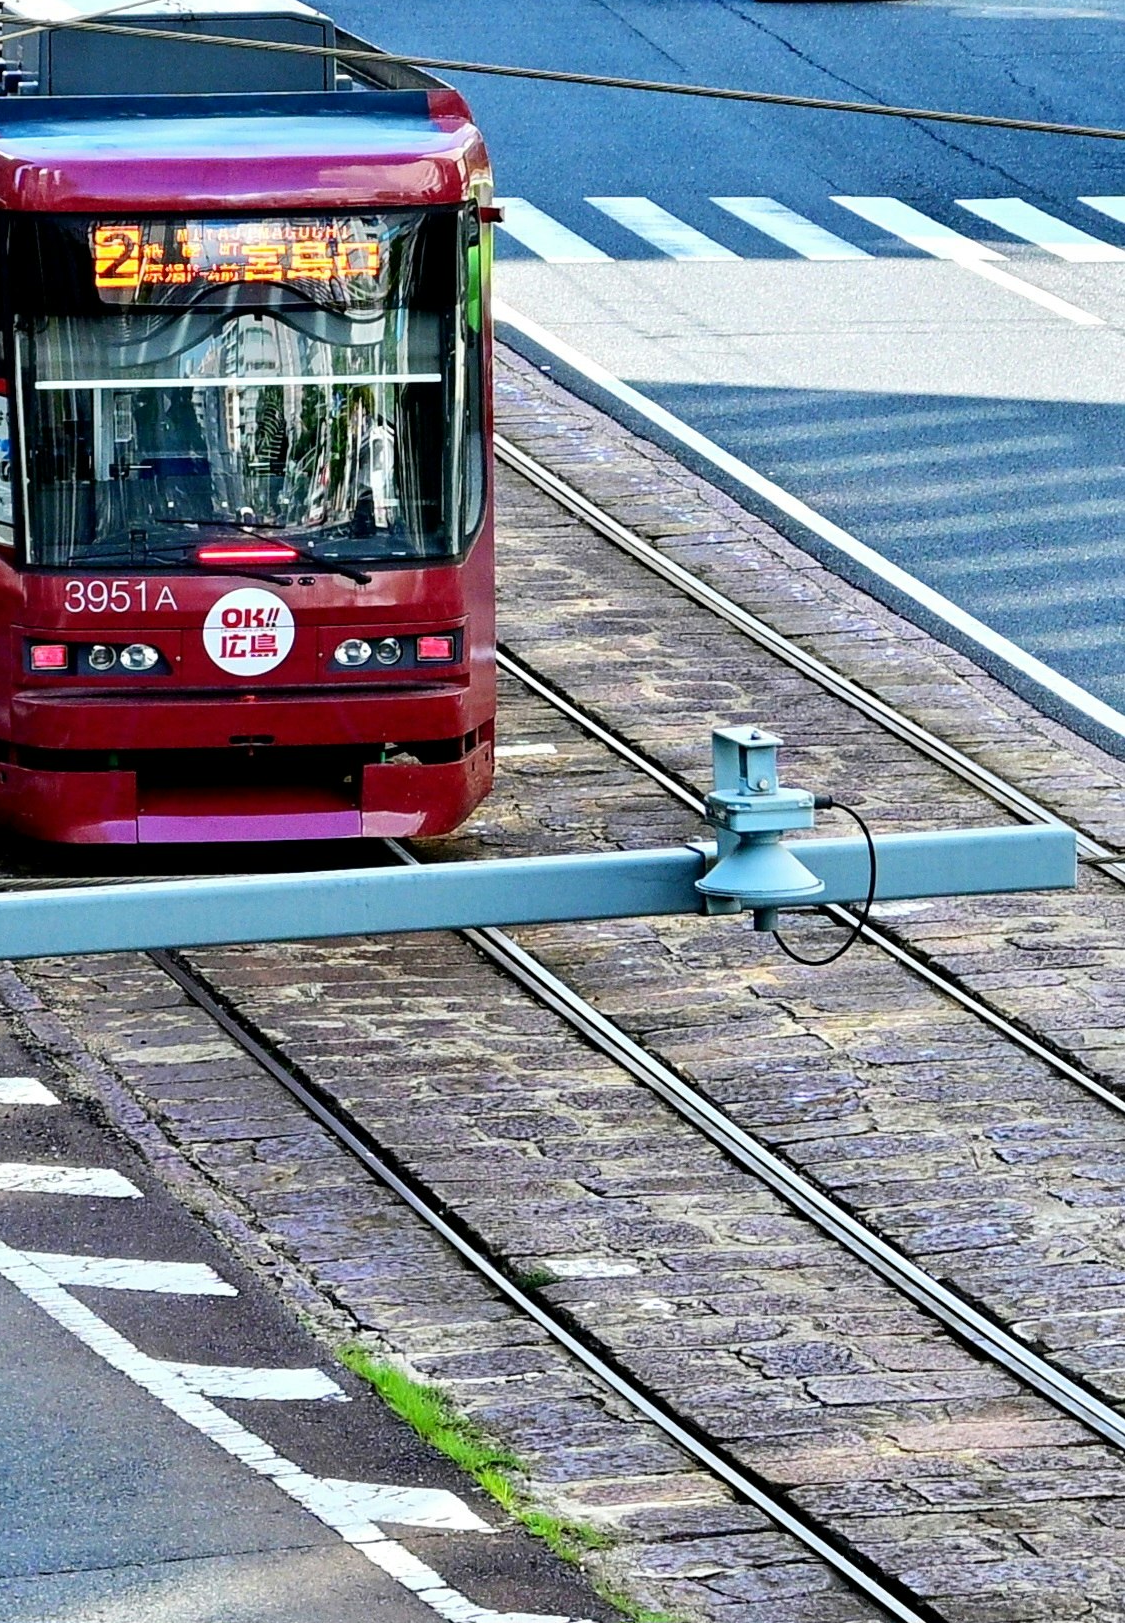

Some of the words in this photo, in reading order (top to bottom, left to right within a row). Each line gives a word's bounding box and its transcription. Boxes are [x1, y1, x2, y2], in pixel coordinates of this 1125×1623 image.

[97, 230, 139, 280] 2
[241, 241, 380, 281] 宮島口
[64, 580, 178, 613] 3951A
[221, 607, 281, 628] OK!!
[219, 634, 278, 659] 広島
